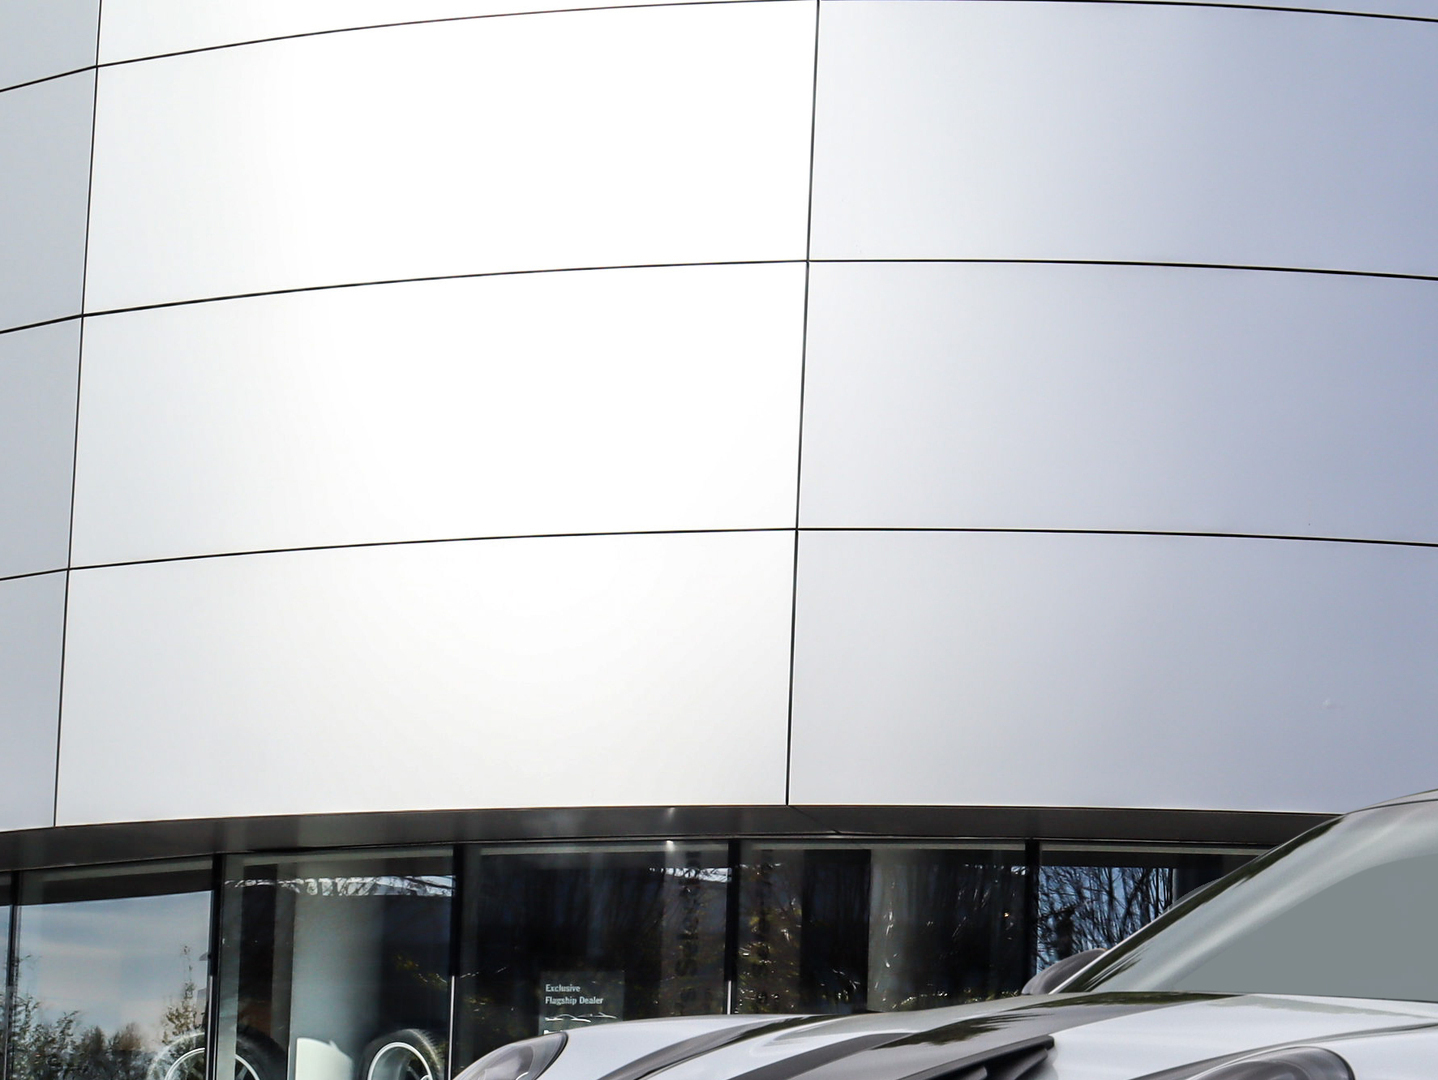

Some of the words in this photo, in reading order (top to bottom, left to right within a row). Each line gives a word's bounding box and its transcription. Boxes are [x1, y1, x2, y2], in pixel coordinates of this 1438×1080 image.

[545, 983, 581, 993] Exclusive
[545, 996, 577, 1006] Flagship
[579, 996, 604, 1005] Dealer
